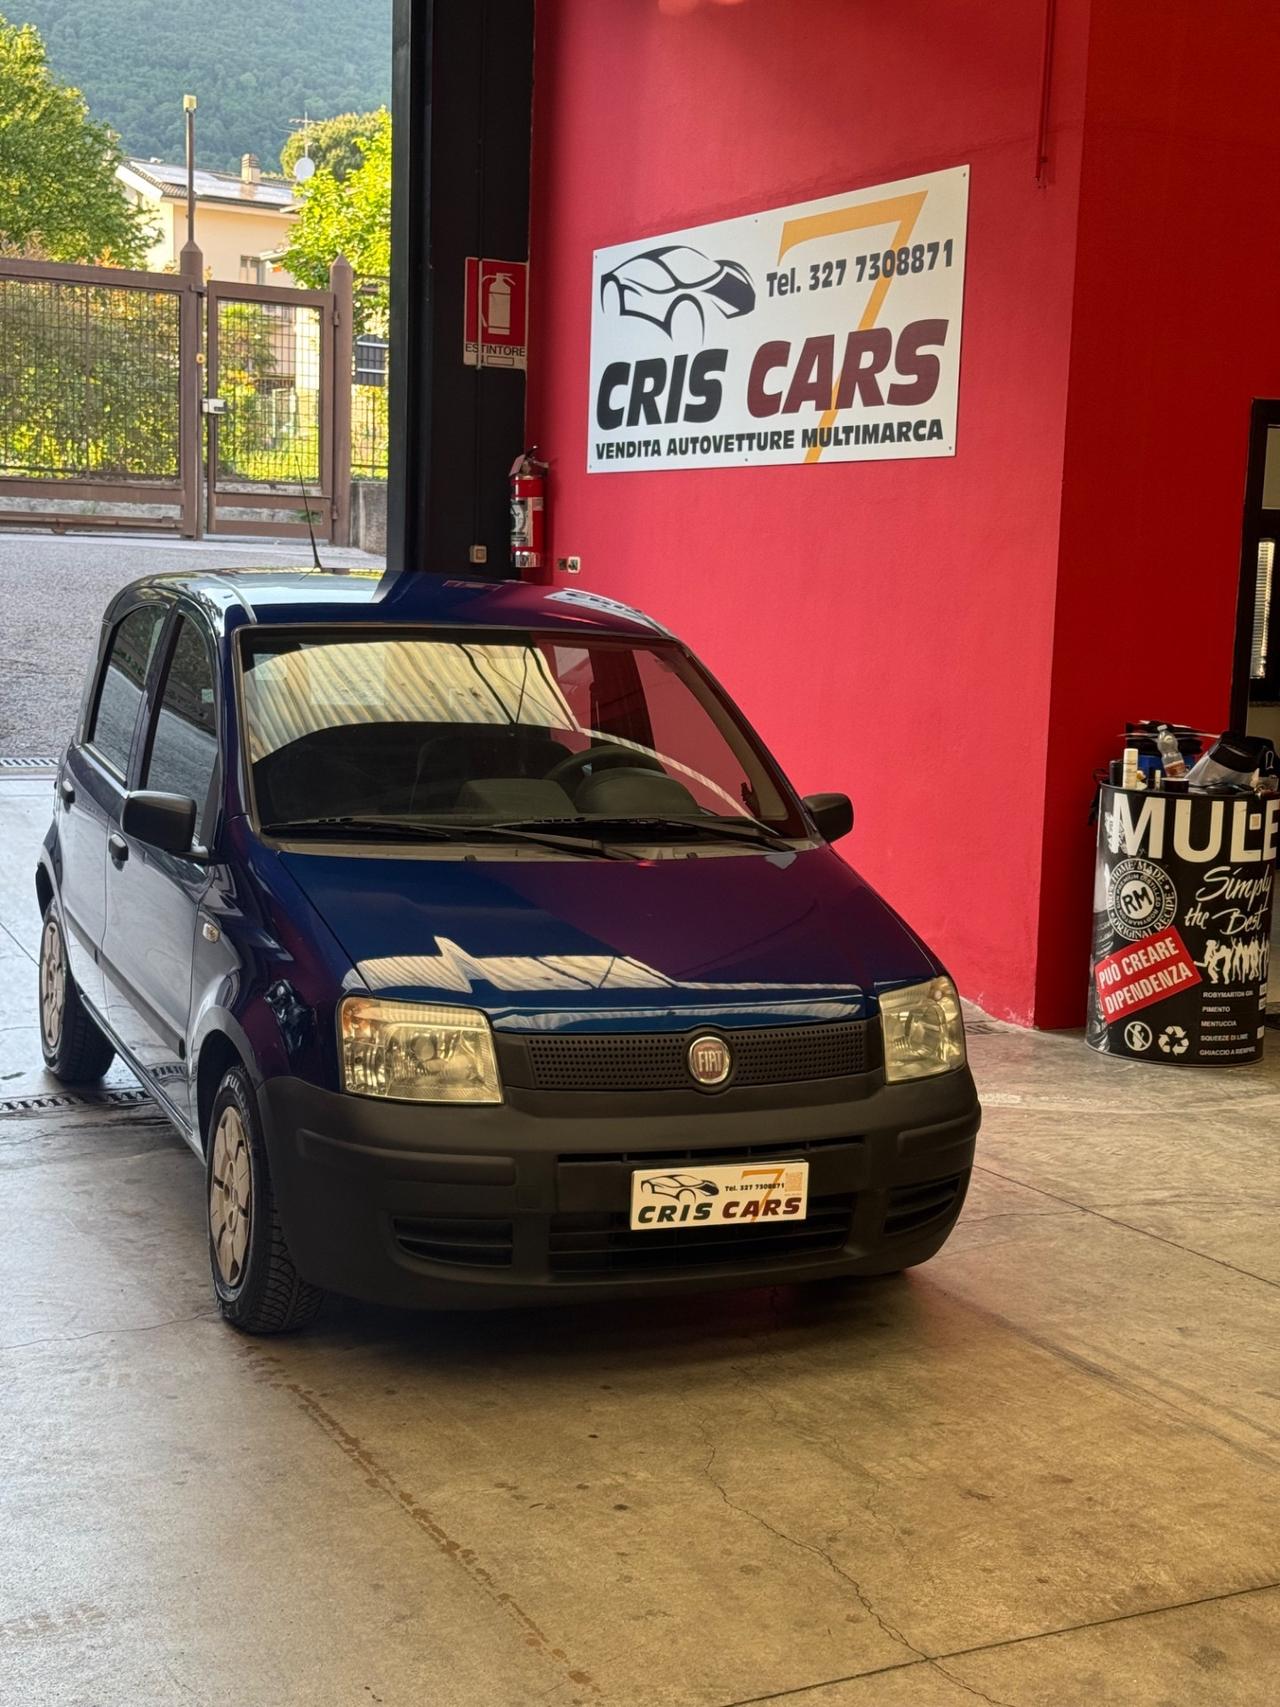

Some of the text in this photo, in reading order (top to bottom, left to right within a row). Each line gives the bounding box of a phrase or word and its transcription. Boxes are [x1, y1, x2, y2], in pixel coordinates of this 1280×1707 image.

[766, 238, 954, 298] Tel. 327 7308871
[465, 343, 526, 357] ESTINTORE
[596, 318, 950, 431] CRIS CARS
[595, 418, 944, 460] VENDITA AUTOVETTURE MULTIMARCA
[1122, 886, 1153, 914] RM
[1195, 863, 1272, 912] Simply
[1112, 892, 1175, 939] ORIGINAL RECIPE
[1184, 902, 1269, 935] the Best
[1098, 937, 1179, 990] PUÒ CREARE
[1104, 961, 1193, 1015] DIPENDENZA
[697, 1050, 723, 1073] FIAT
[637, 1197, 802, 1224] CRIS CARS
